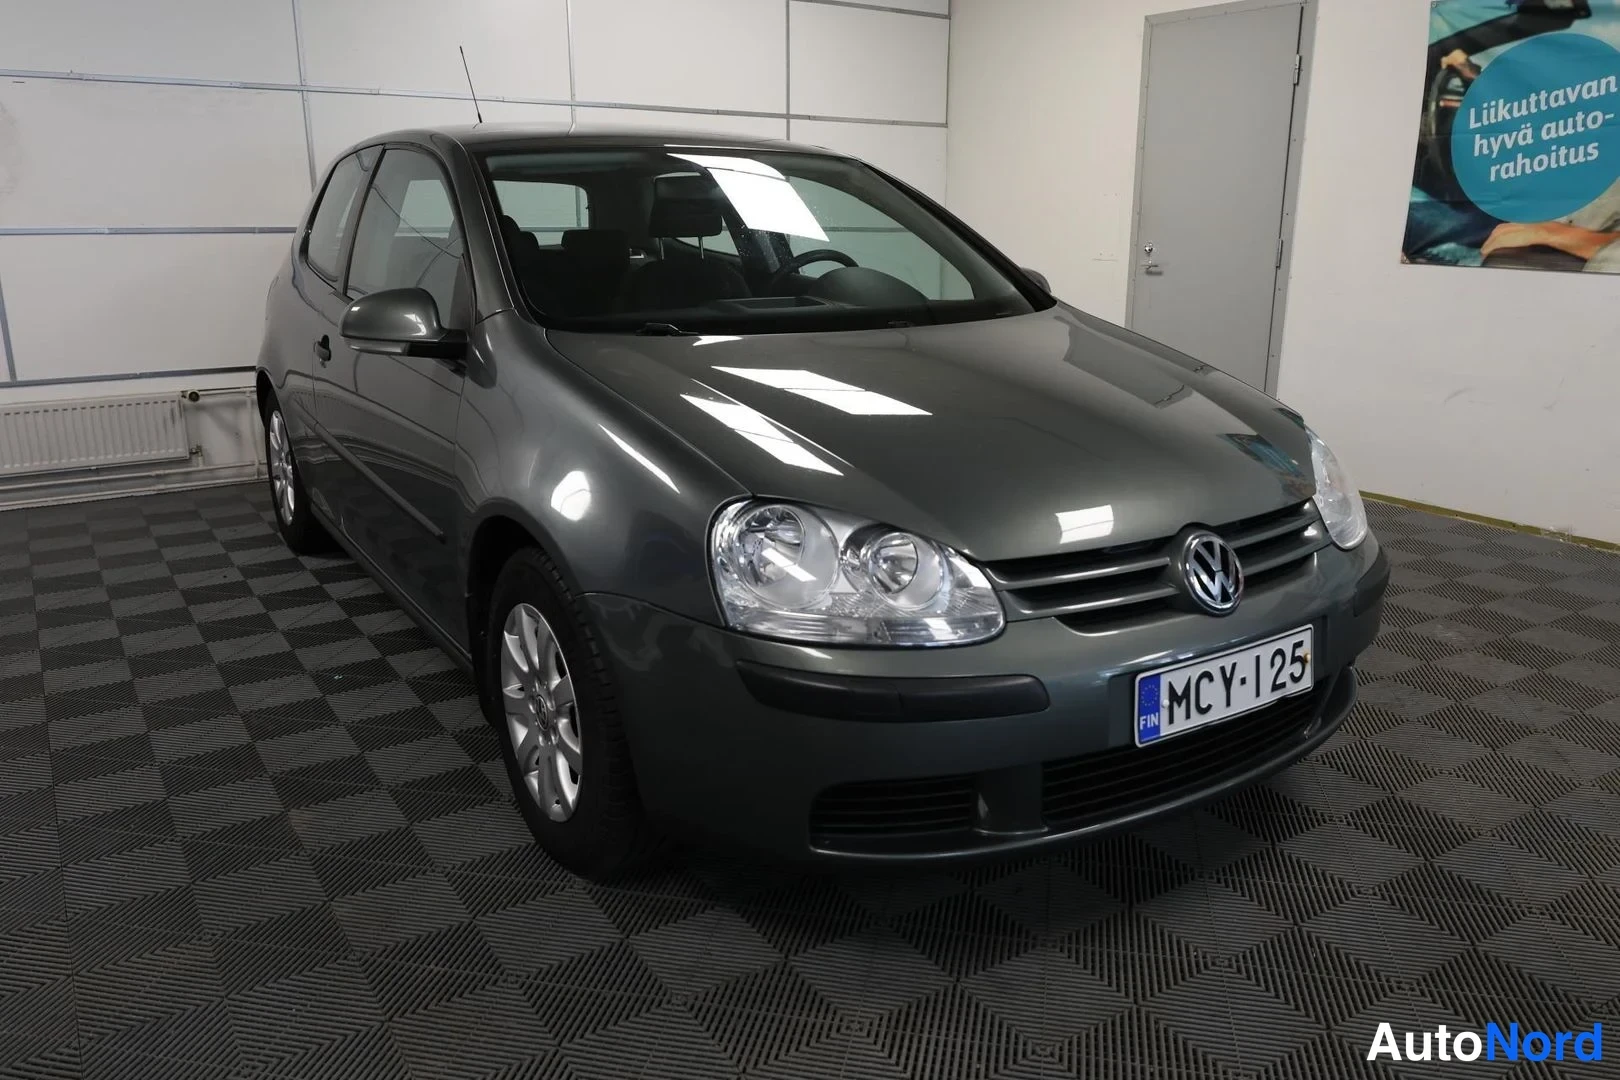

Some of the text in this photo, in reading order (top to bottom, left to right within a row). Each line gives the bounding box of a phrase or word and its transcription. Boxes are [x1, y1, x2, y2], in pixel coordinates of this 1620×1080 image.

[1468, 74, 1618, 130] Liikuttavan
[1473, 109, 1615, 159] hyvä auto-
[1489, 142, 1600, 183] rahoitus
[1139, 712, 1159, 731] FIN
